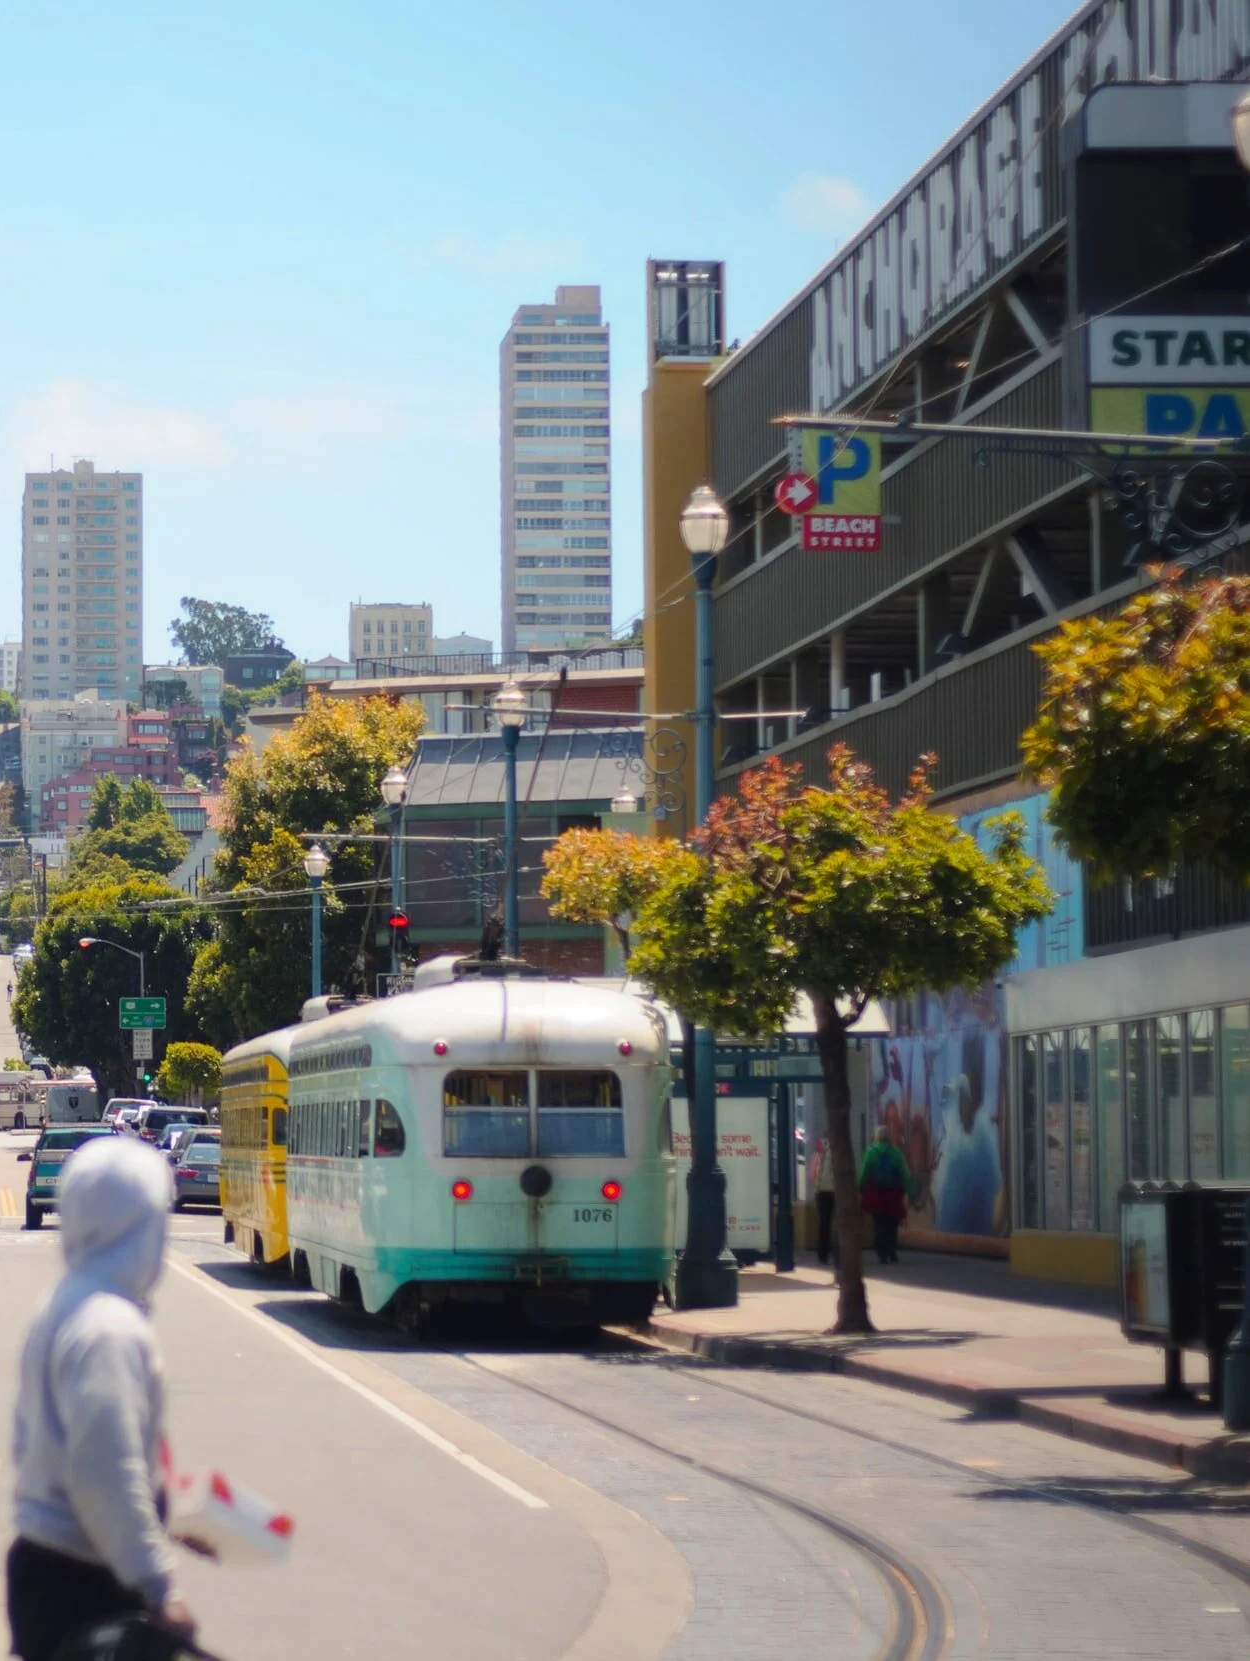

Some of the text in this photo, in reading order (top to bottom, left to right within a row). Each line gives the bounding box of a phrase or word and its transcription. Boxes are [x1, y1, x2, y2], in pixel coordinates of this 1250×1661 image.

[810, 72, 1042, 412] ANCHORAGE
[1112, 329, 1250, 367] STAR
[818, 436, 871, 504] P
[811, 518, 876, 533] BEACH
[811, 537, 876, 547] STREET
[721, 1133, 752, 1144] some
[736, 1145, 761, 1158] wait.
[573, 1208, 613, 1223] 1076
